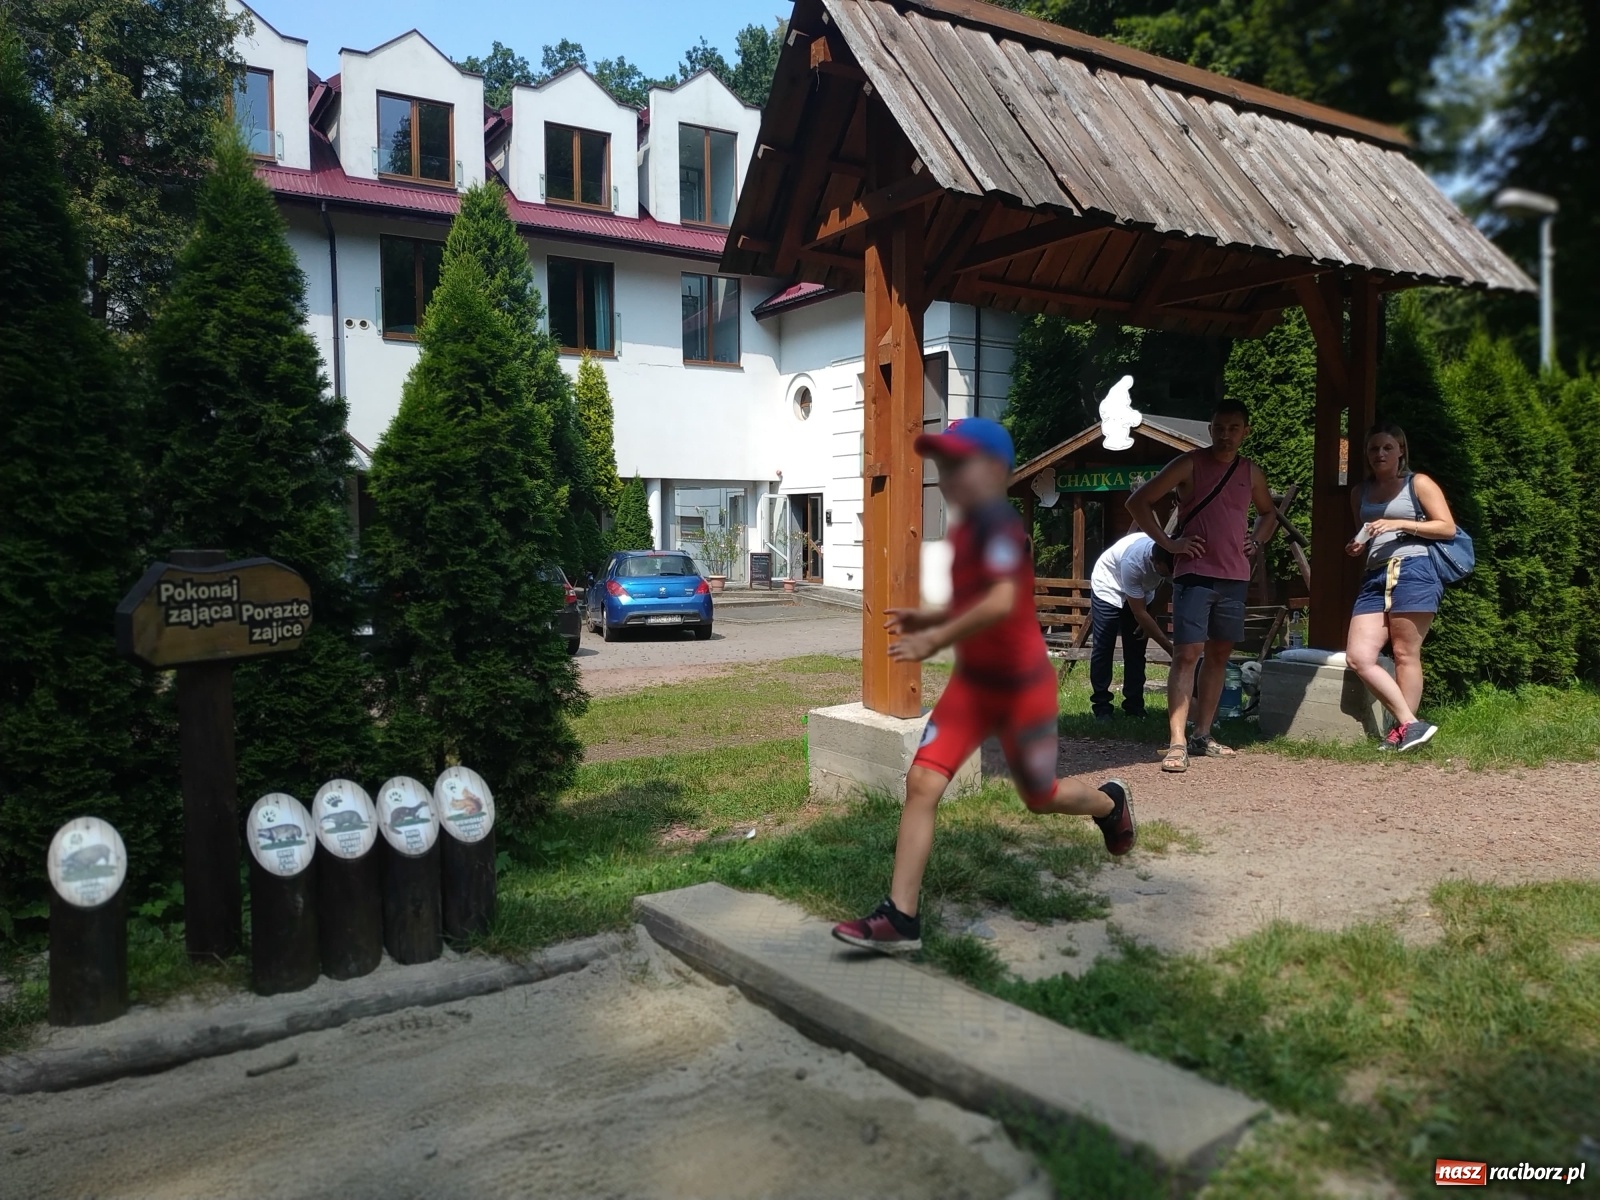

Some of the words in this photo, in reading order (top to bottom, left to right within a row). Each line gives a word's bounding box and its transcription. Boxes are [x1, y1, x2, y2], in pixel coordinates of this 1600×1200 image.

[1056, 472, 1125, 488] CHATKA
[160, 579, 238, 602] Pokonaj
[168, 603, 233, 626] zająca
[252, 621, 303, 643] zajíce
